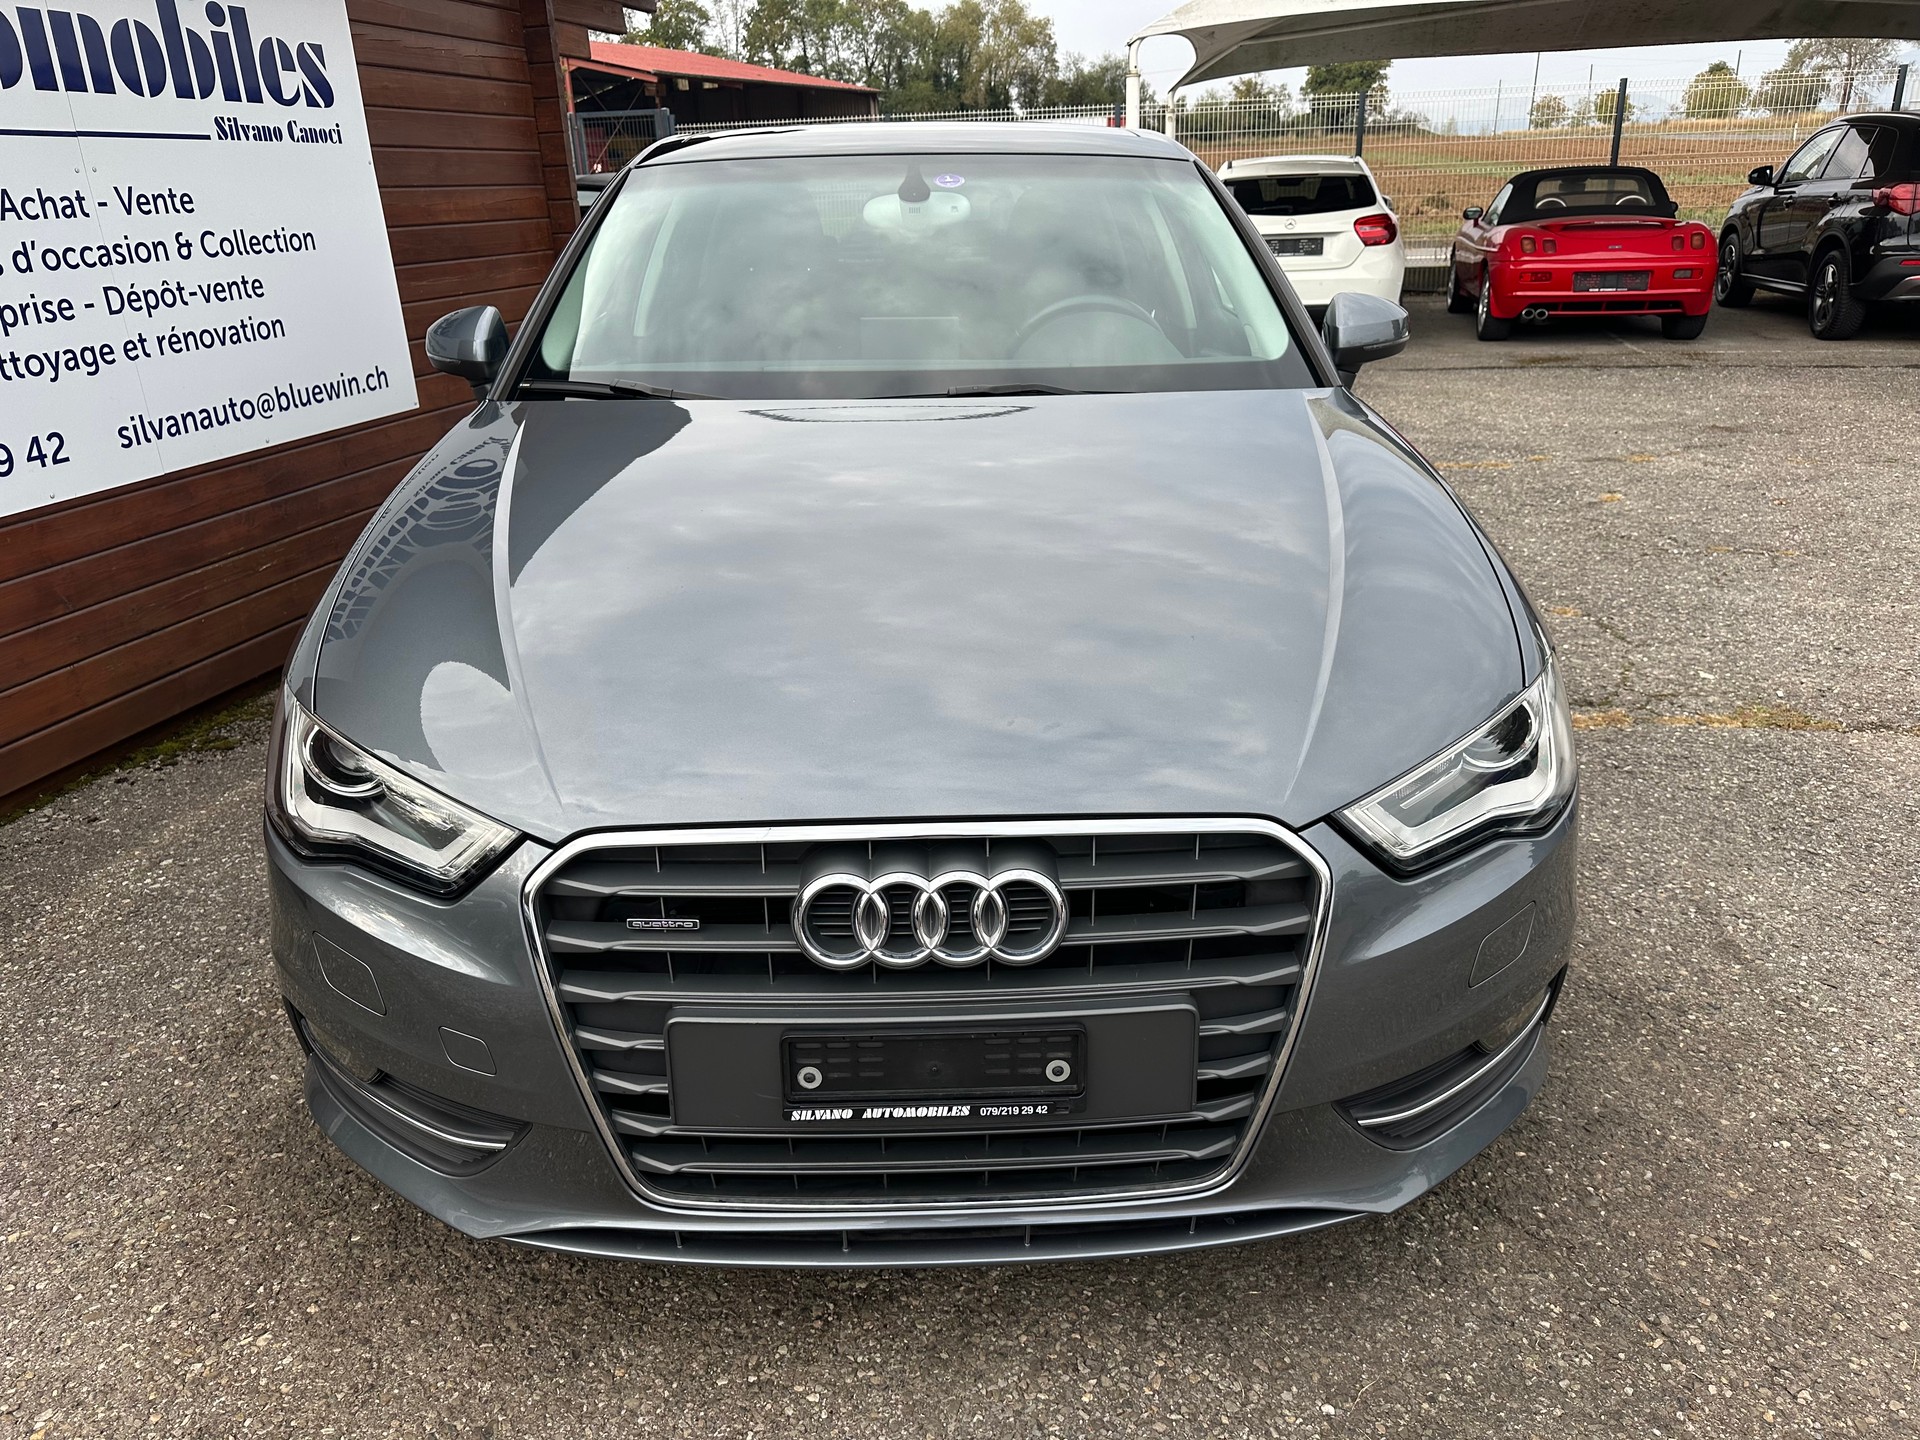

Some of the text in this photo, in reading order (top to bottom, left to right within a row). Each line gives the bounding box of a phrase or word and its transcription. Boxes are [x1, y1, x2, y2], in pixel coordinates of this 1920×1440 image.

[214, 116, 343, 145] Silvano Canoci
[0, 187, 91, 222] Achat
[113, 186, 196, 216] Vente
[12, 235, 170, 274] d'occasion
[174, 231, 193, 260] &
[199, 226, 317, 259] Collection
[102, 275, 265, 319] Dépôt-vente
[122, 331, 152, 362] et
[155, 315, 286, 357] rénovation
[117, 365, 390, 450] silvanauto@bluewin.ch
[26, 431, 71, 468] 42
[632, 921, 694, 929] quattro
[791, 1101, 1048, 1121] SILVANO AUTOMOBILES 079/219 29 42
